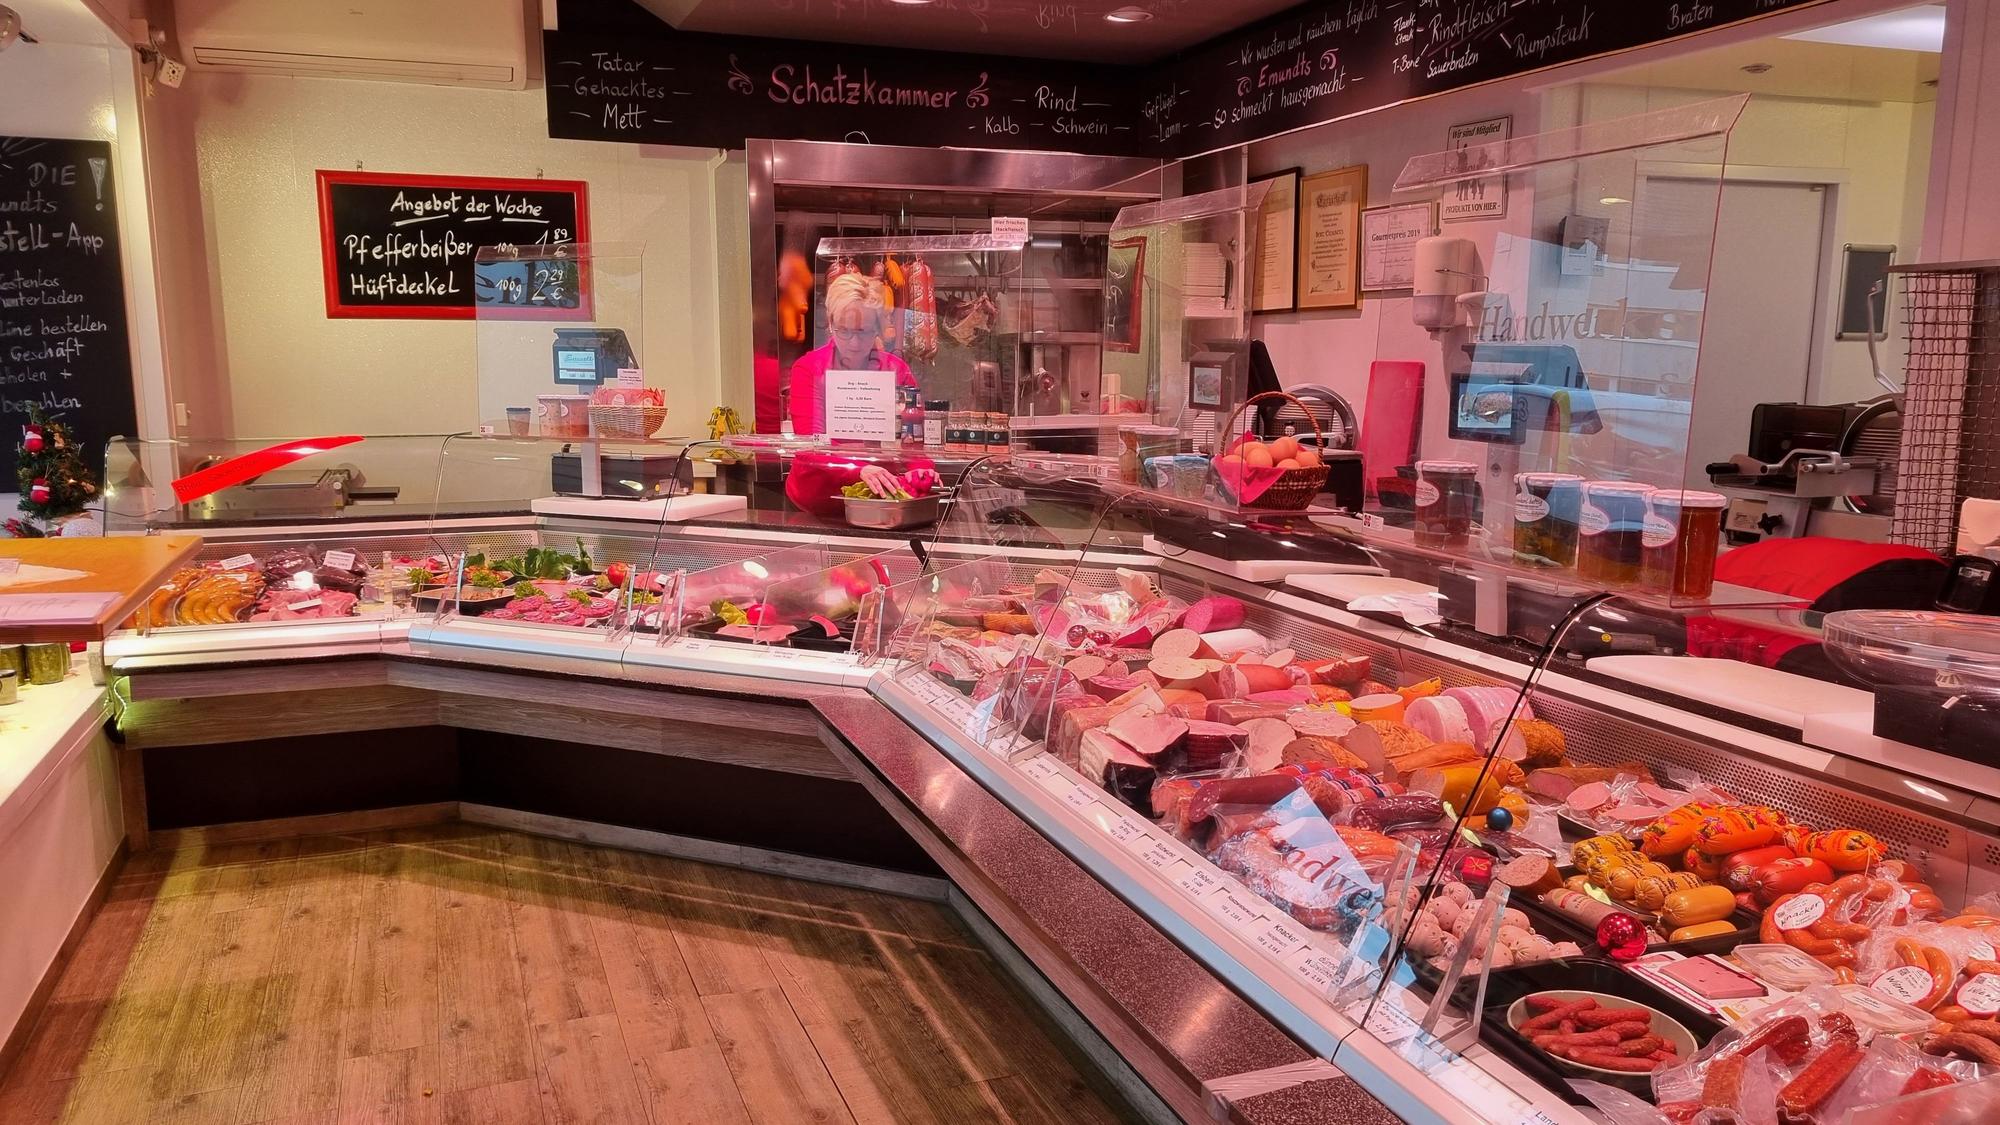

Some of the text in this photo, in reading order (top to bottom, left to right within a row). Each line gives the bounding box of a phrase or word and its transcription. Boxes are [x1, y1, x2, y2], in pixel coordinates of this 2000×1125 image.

[1429, 2, 1508, 44] Rindfleisch
[1667, 4, 1714, 31] Braten
[1256, 33, 1286, 61] wursten
[1287, 25, 1303, 50] und
[1306, 17, 1342, 44] räuchern
[1345, 3, 1378, 33] täglich
[1514, 5, 1595, 59] Rumpsteak
[592, 53, 644, 73] Tatar
[1257, 53, 1312, 88] Emundts
[1392, 57, 1420, 74] T-Bone
[1427, 43, 1479, 78] Sauerbraten
[574, 76, 665, 99] Gehacktes
[768, 63, 957, 108] Schatzkammer
[1231, 92, 1274, 124] schmeckt
[1280, 66, 1346, 107] hausgemacht
[1035, 86, 1078, 112] Rind
[1145, 83, 1177, 121] Geflügel
[603, 104, 648, 130] Mett
[985, 116, 1108, 135] Kalb Schwein
[1463, 126, 1476, 137] sind
[1476, 122, 1502, 136] Mitglied
[1159, 122, 1181, 142] Lamm
[28, 163, 77, 187] DIE
[390, 191, 543, 217] Angebot der Woche
[1471, 202, 1483, 212] VON
[1483, 202, 1498, 211] HIER
[344, 230, 473, 266] Pfefferbeißer
[494, 242, 519, 259] 100g
[351, 270, 460, 301] Hüftdeckel
[495, 279, 522, 301] 100g
[41, 314, 107, 336] bestellen
[11, 337, 84, 363] Geschäft
[1781, 901, 1821, 926] Knacker
[1273, 924, 1300, 943] Knacker
